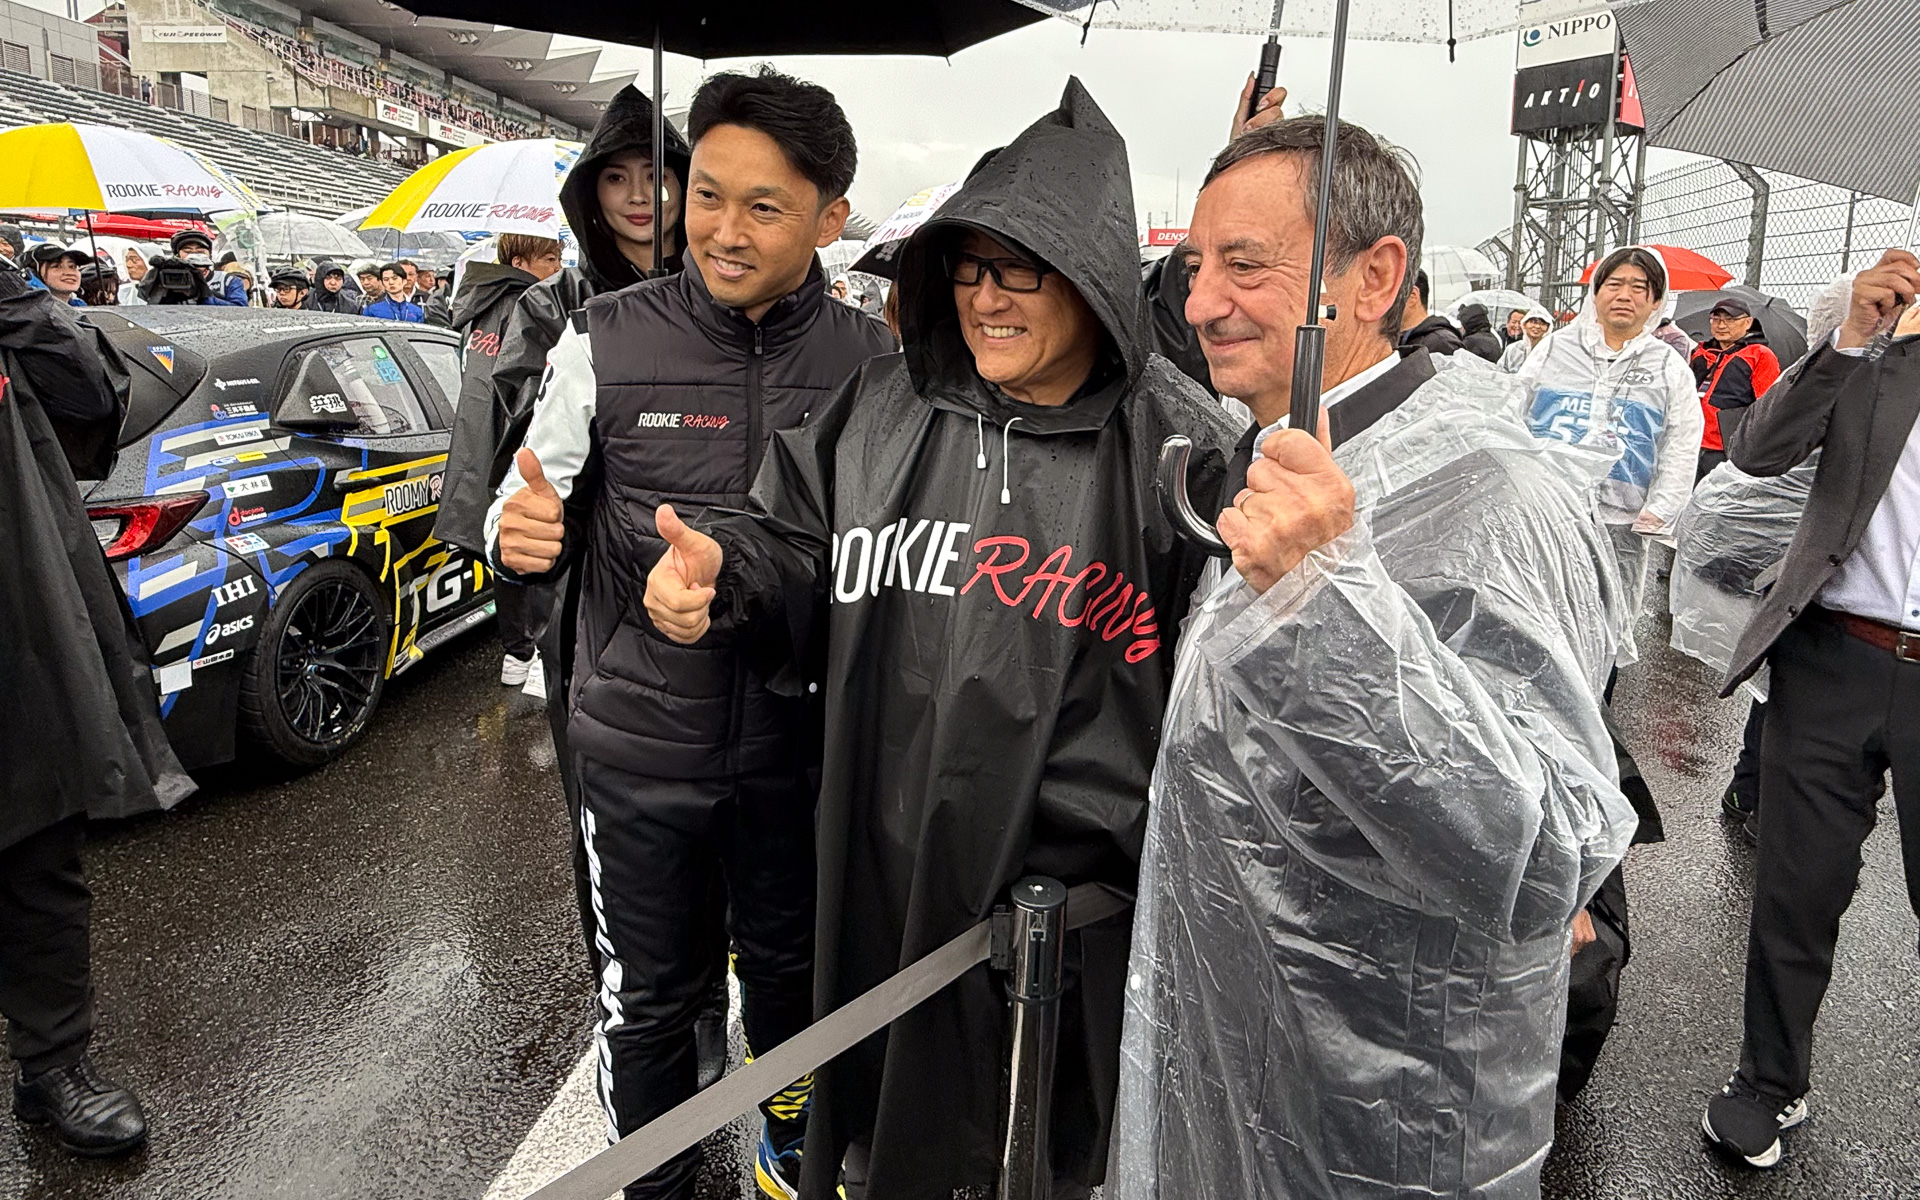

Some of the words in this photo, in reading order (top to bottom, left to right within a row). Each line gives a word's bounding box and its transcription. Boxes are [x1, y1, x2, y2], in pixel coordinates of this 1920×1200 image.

[1547, 13, 1611, 39] NIPPO
[1523, 79, 1600, 108] AKTIO
[106, 183, 162, 198] ROOKIE
[162, 184, 224, 199] RACING
[421, 203, 490, 218] ROOKIE
[487, 204, 556, 223] RACING
[638, 413, 682, 428] ROOKIE
[682, 414, 730, 430] RACING
[385, 479, 429, 515] ROOMY
[211, 574, 258, 608] IHI
[960, 535, 1162, 664] RACING
[221, 615, 254, 636] asics
